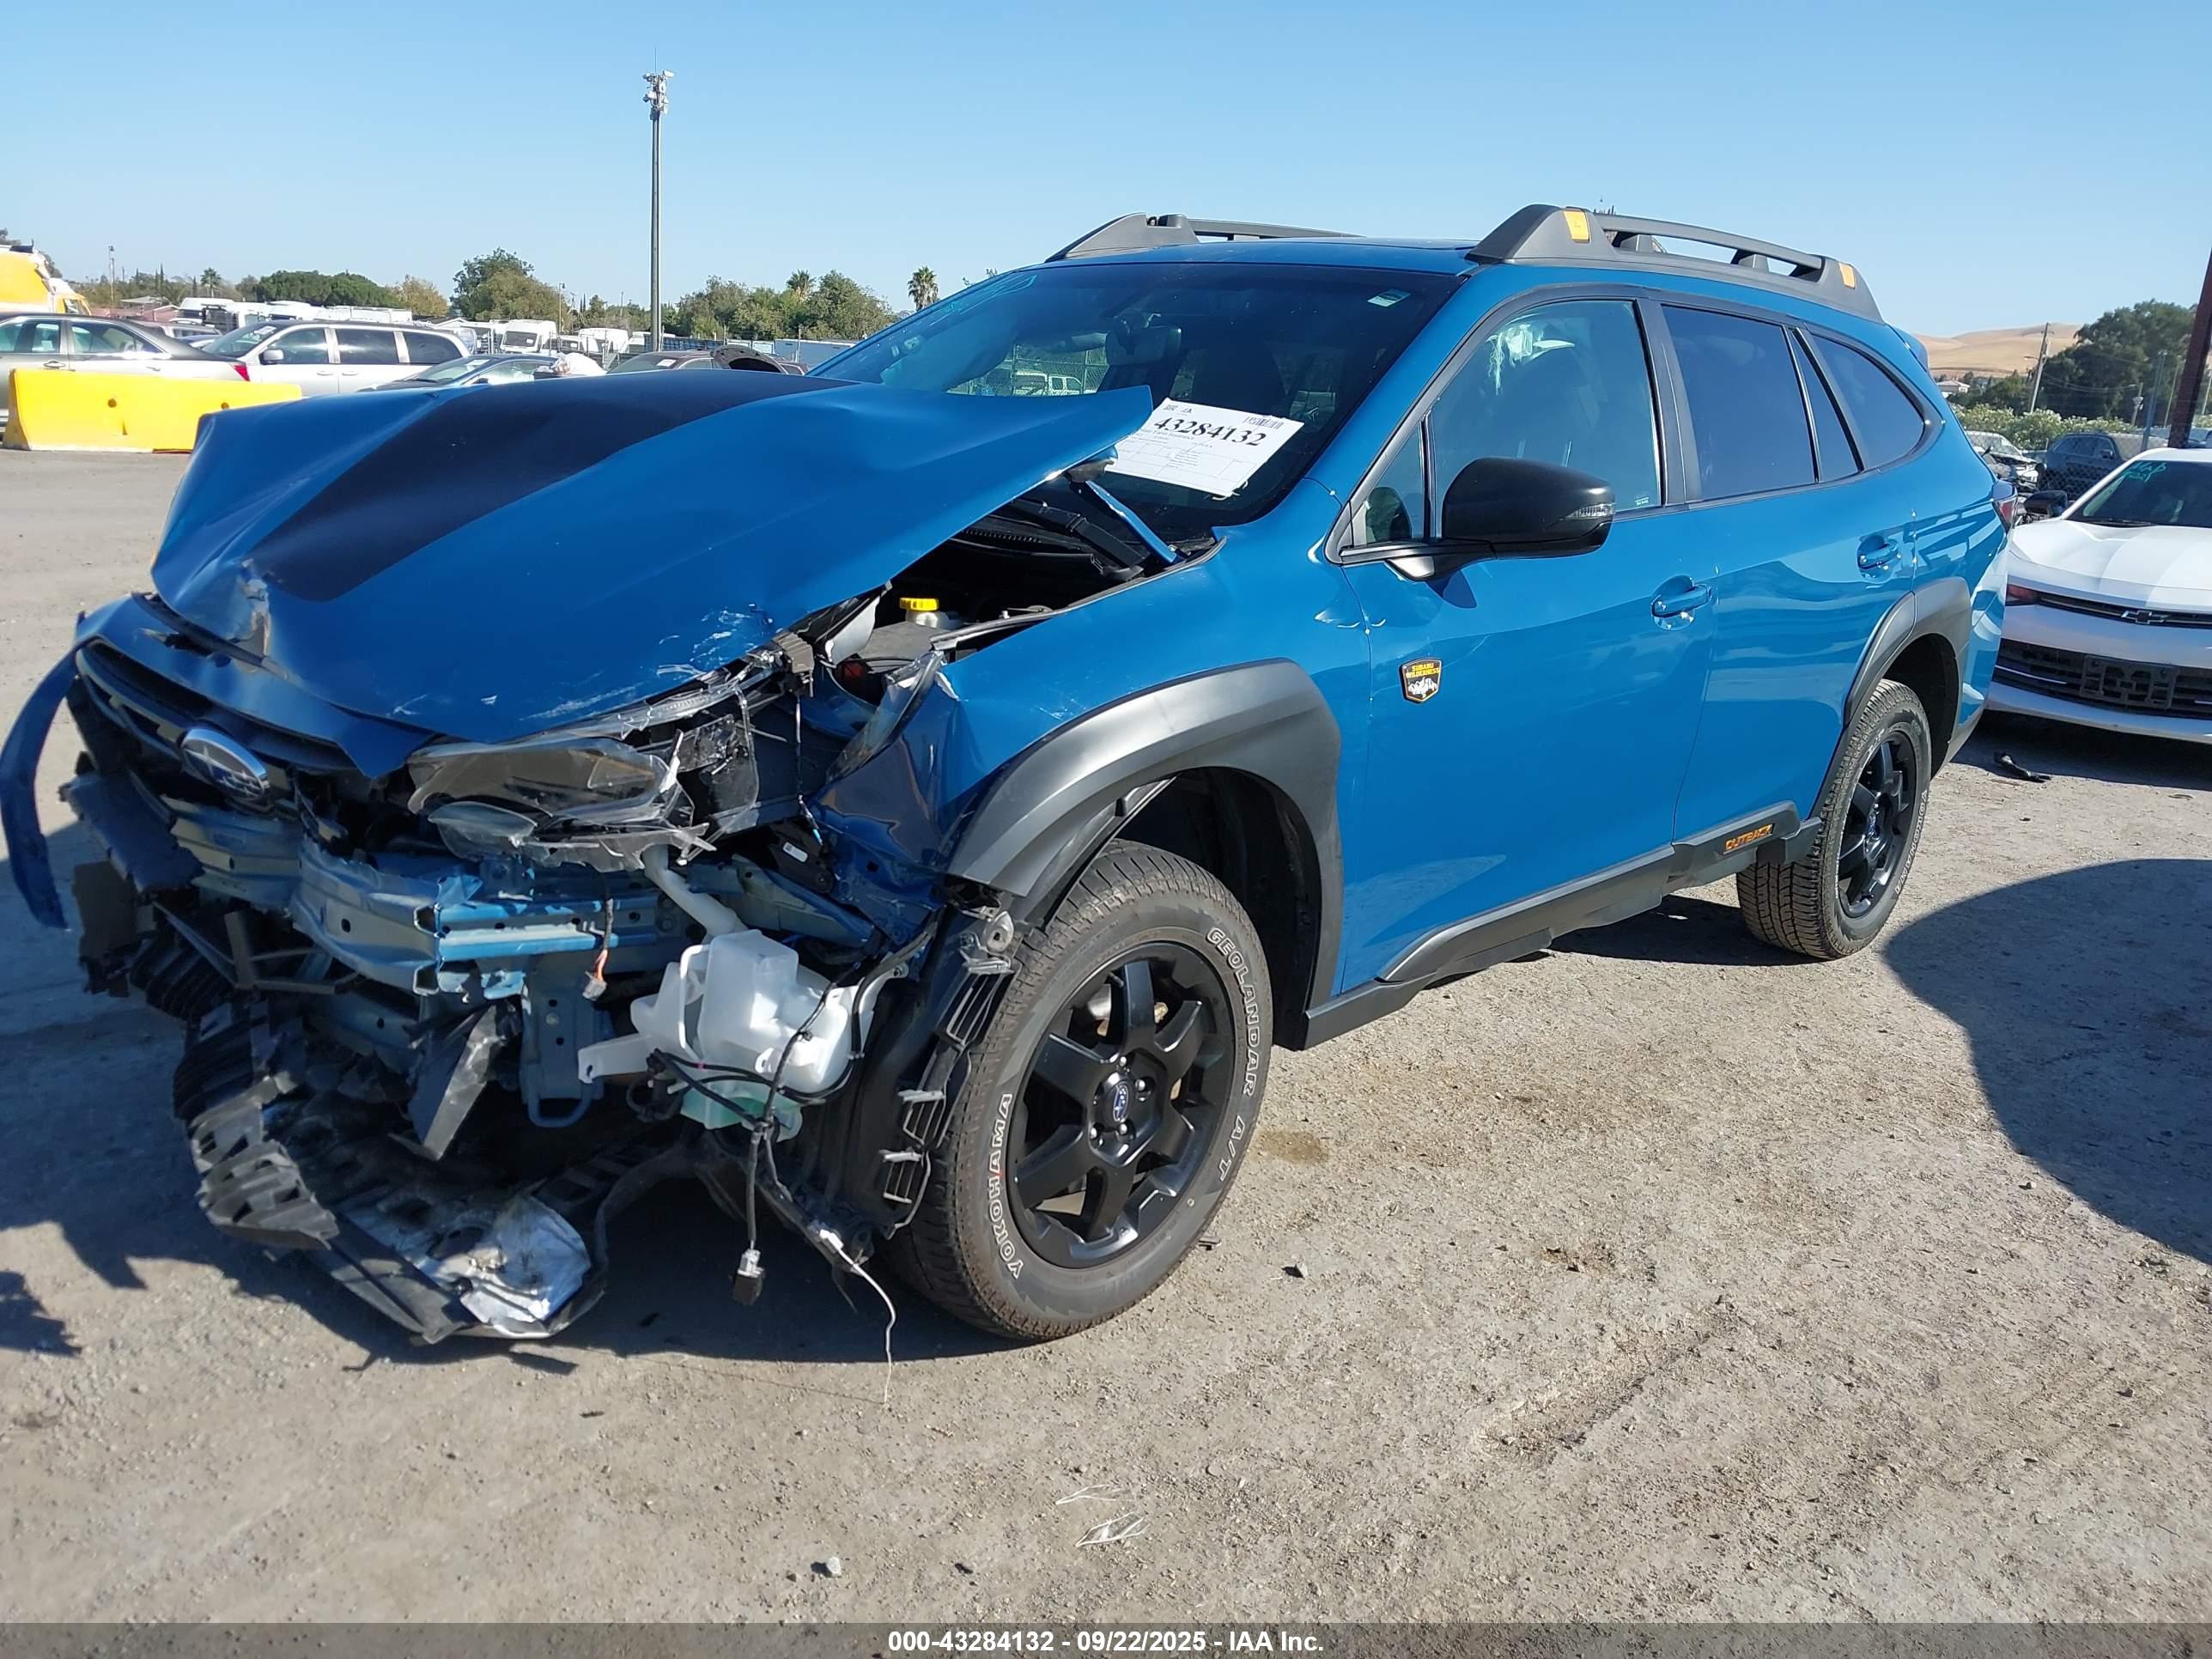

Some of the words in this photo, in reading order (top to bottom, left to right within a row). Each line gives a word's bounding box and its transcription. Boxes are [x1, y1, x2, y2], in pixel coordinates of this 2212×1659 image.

[1153, 416, 1267, 447] 43284132
[1406, 667, 1441, 679] WILDERNESS
[1894, 789, 1929, 895] YOKOHAMA
[1206, 927, 1261, 1097] GEOLANDAR
[988, 1092, 1024, 1279] YOKOHAMA
[1214, 1114, 1246, 1183] A/T
